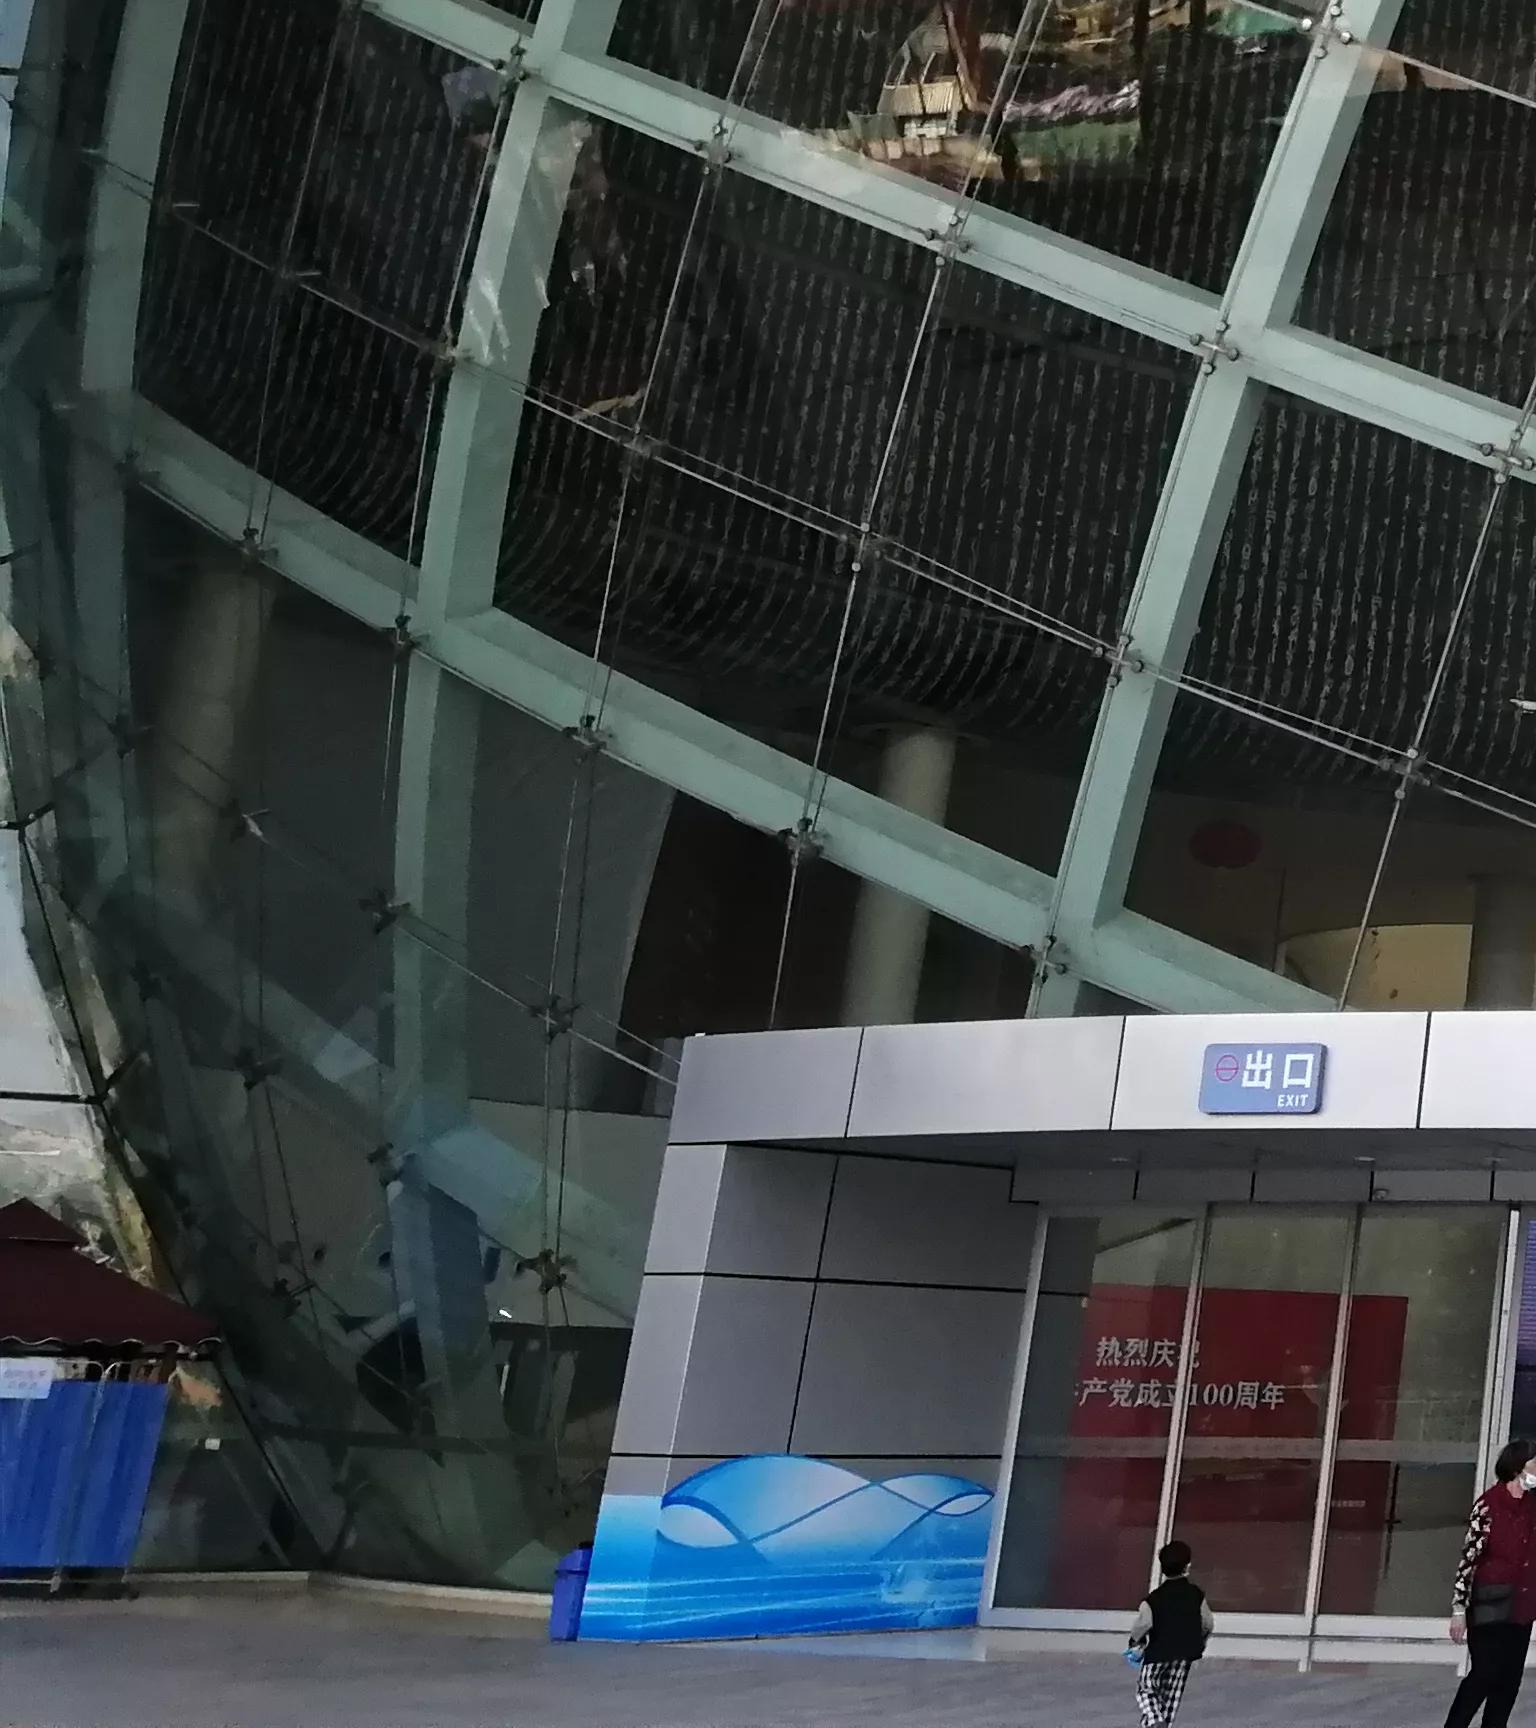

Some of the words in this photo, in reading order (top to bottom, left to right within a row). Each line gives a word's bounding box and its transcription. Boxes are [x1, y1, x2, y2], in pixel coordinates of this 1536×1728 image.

[1241, 1050, 1315, 1090] 出口
[1277, 1094, 1309, 1108] EXIT
[1074, 1377, 1286, 1411] 产党成立100周年
